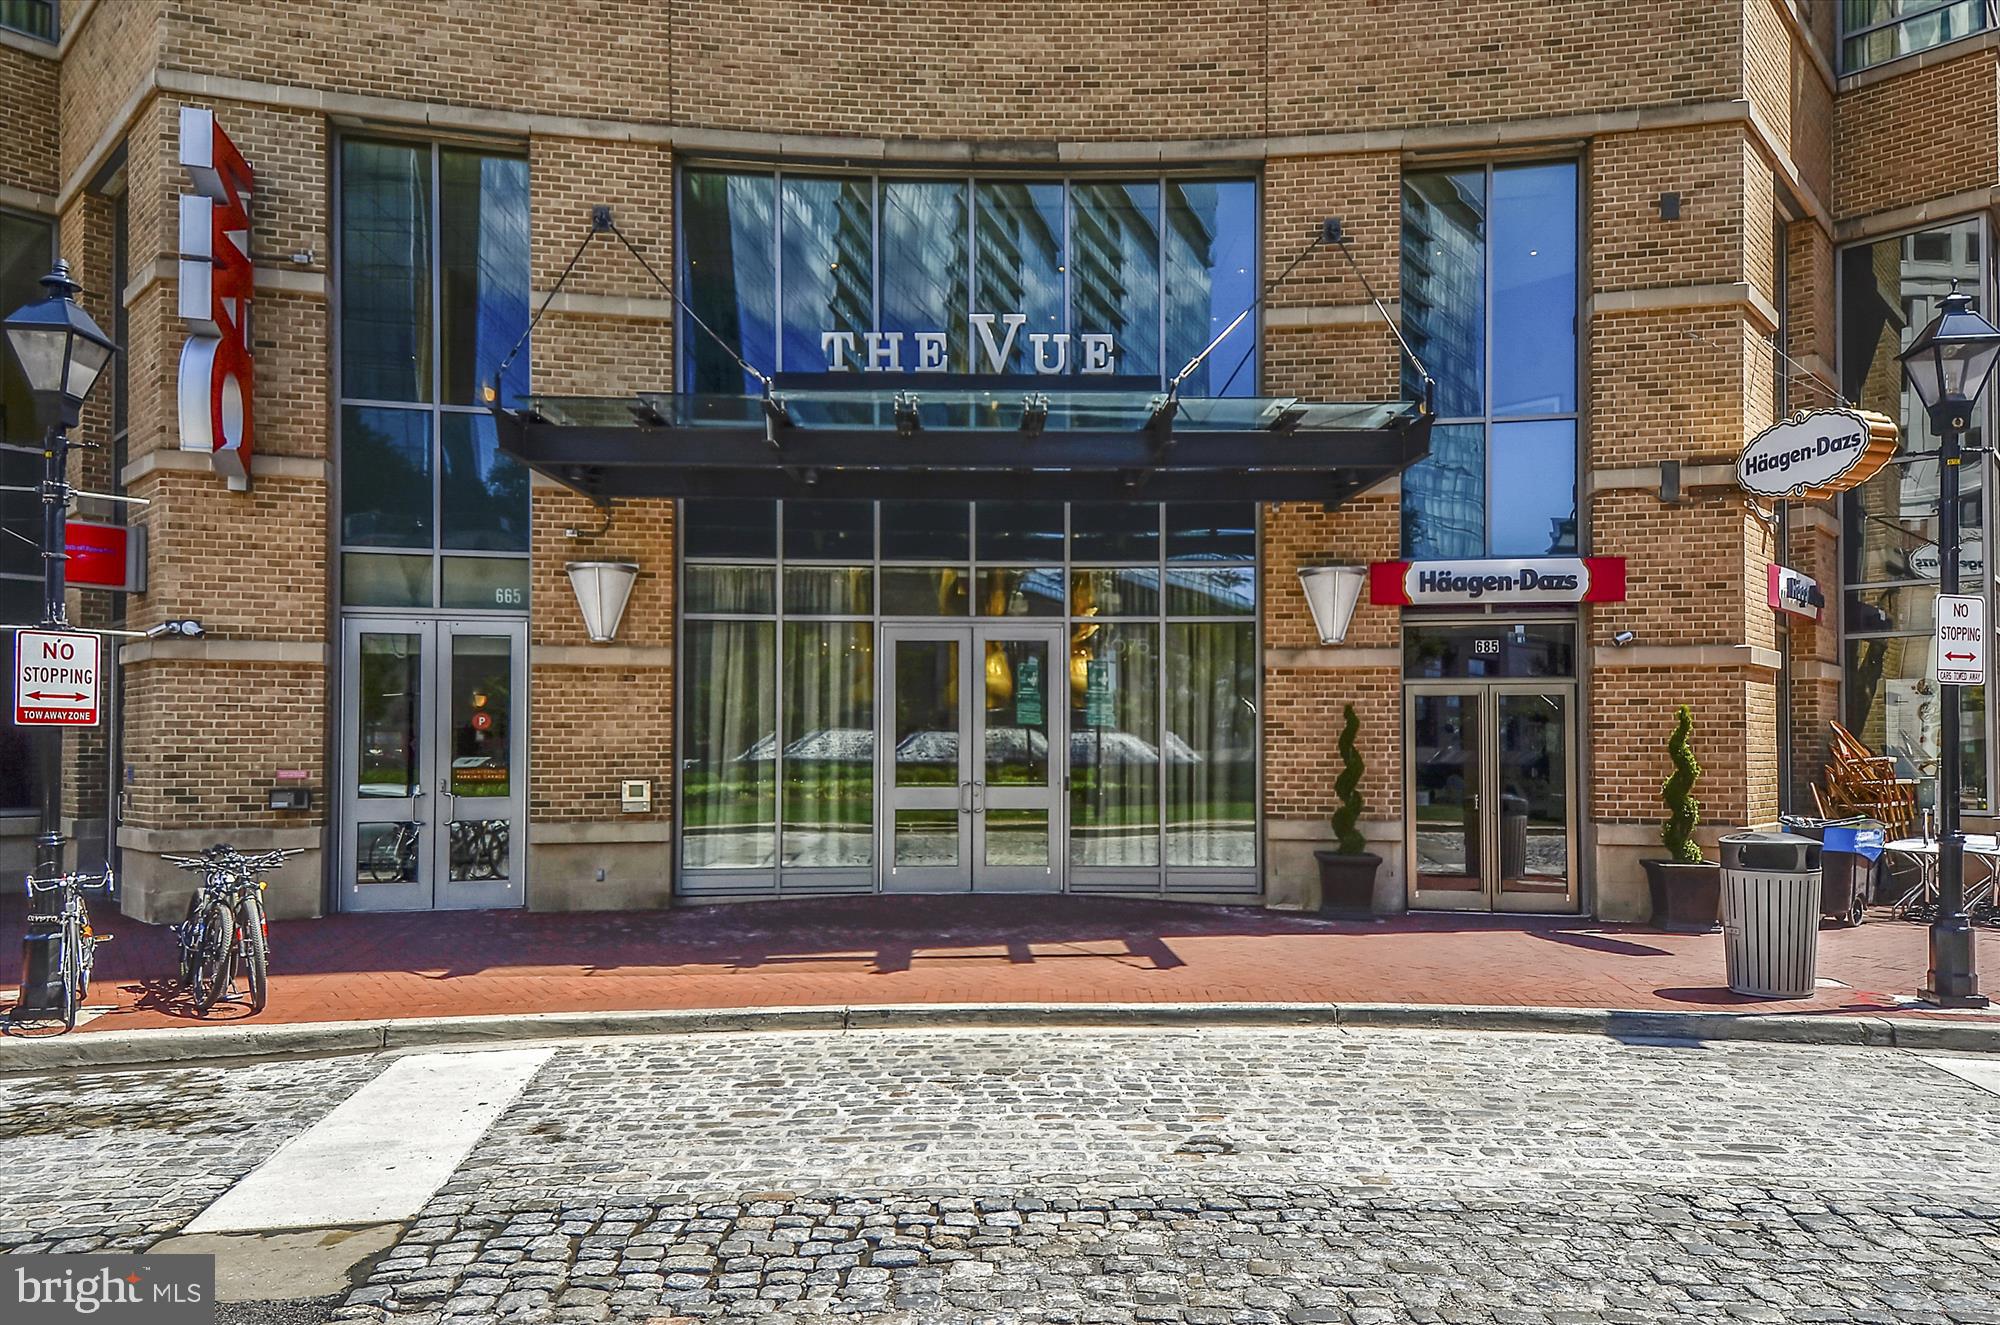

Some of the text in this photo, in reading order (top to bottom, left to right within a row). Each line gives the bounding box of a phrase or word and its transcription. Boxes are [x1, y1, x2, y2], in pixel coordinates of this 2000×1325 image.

[821, 332, 948, 372] THE
[1745, 433, 1861, 476] Häagen-Dazs
[1419, 568, 1579, 598] Häagen-Dazs
[496, 588, 520, 603] 665
[1953, 603, 1969, 618] NO
[1940, 626, 1981, 642] STOPPING
[43, 641, 75, 660] NO
[1476, 640, 1498, 653] 685
[23, 666, 93, 685] STOPPING
[1940, 671, 1981, 681] CARS TOWED AWAY
[24, 710, 91, 721] TOW AWAY ZONE
